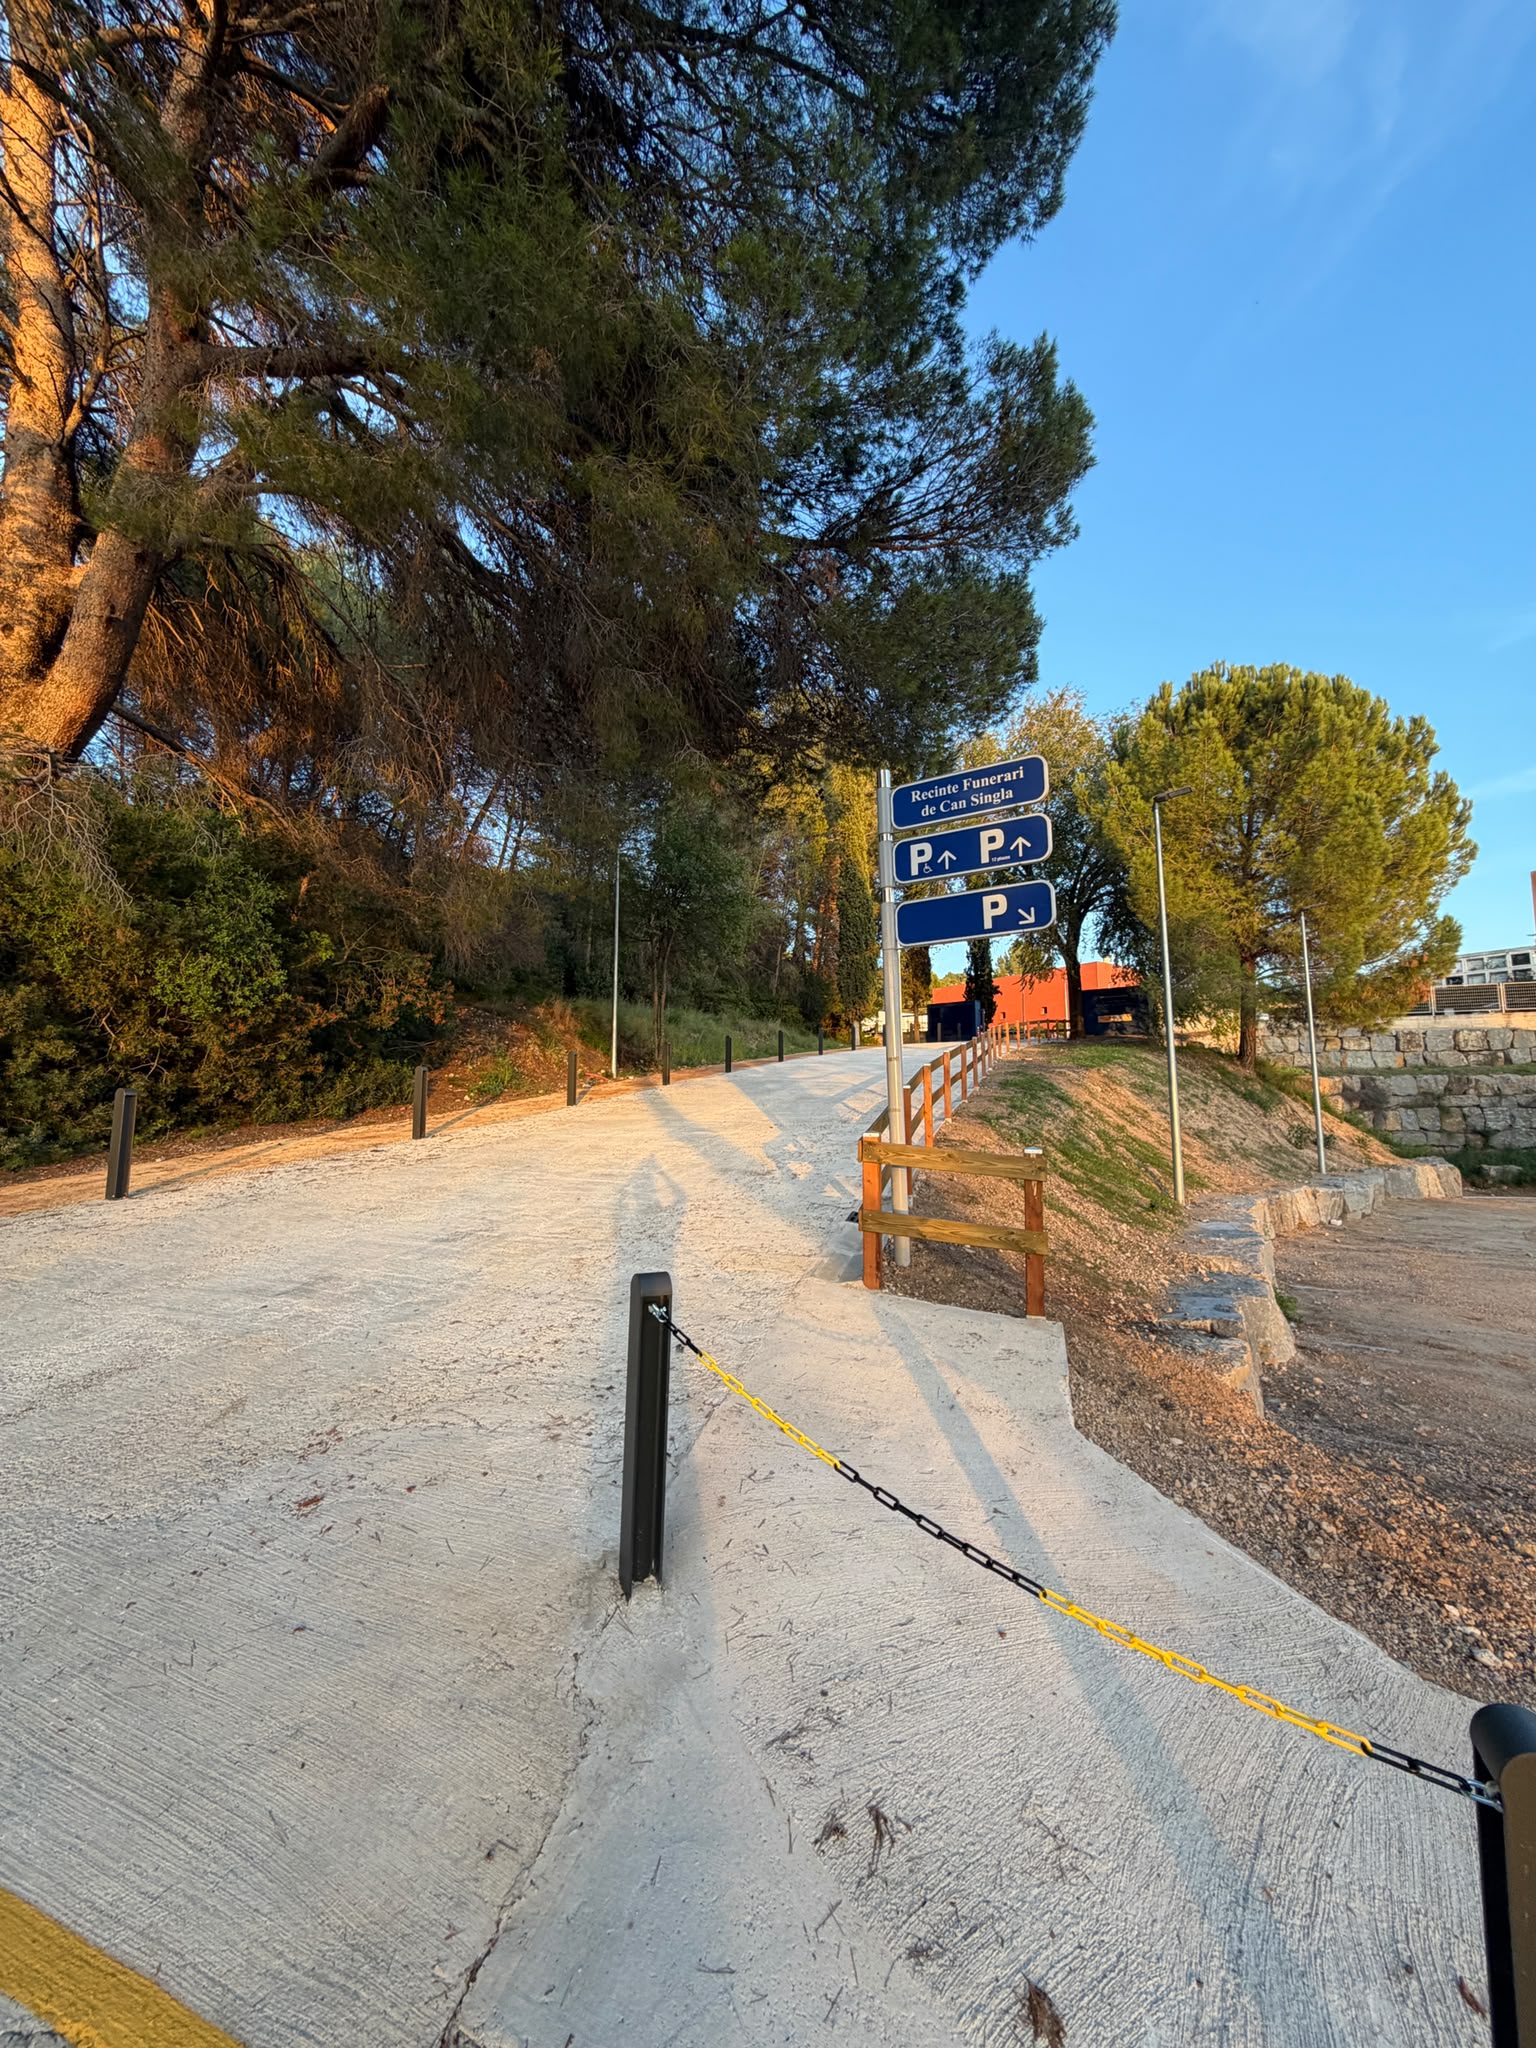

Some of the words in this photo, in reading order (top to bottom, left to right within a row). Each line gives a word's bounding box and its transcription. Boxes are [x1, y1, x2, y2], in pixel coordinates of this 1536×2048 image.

[911, 782, 959, 803] Recinte
[962, 766, 1024, 791] Funerari
[921, 802, 936, 817] de
[940, 798, 966, 813] Can
[971, 788, 1013, 806] Singla
[910, 843, 932, 876] P
[980, 829, 1004, 864] P
[982, 894, 1007, 929] P
